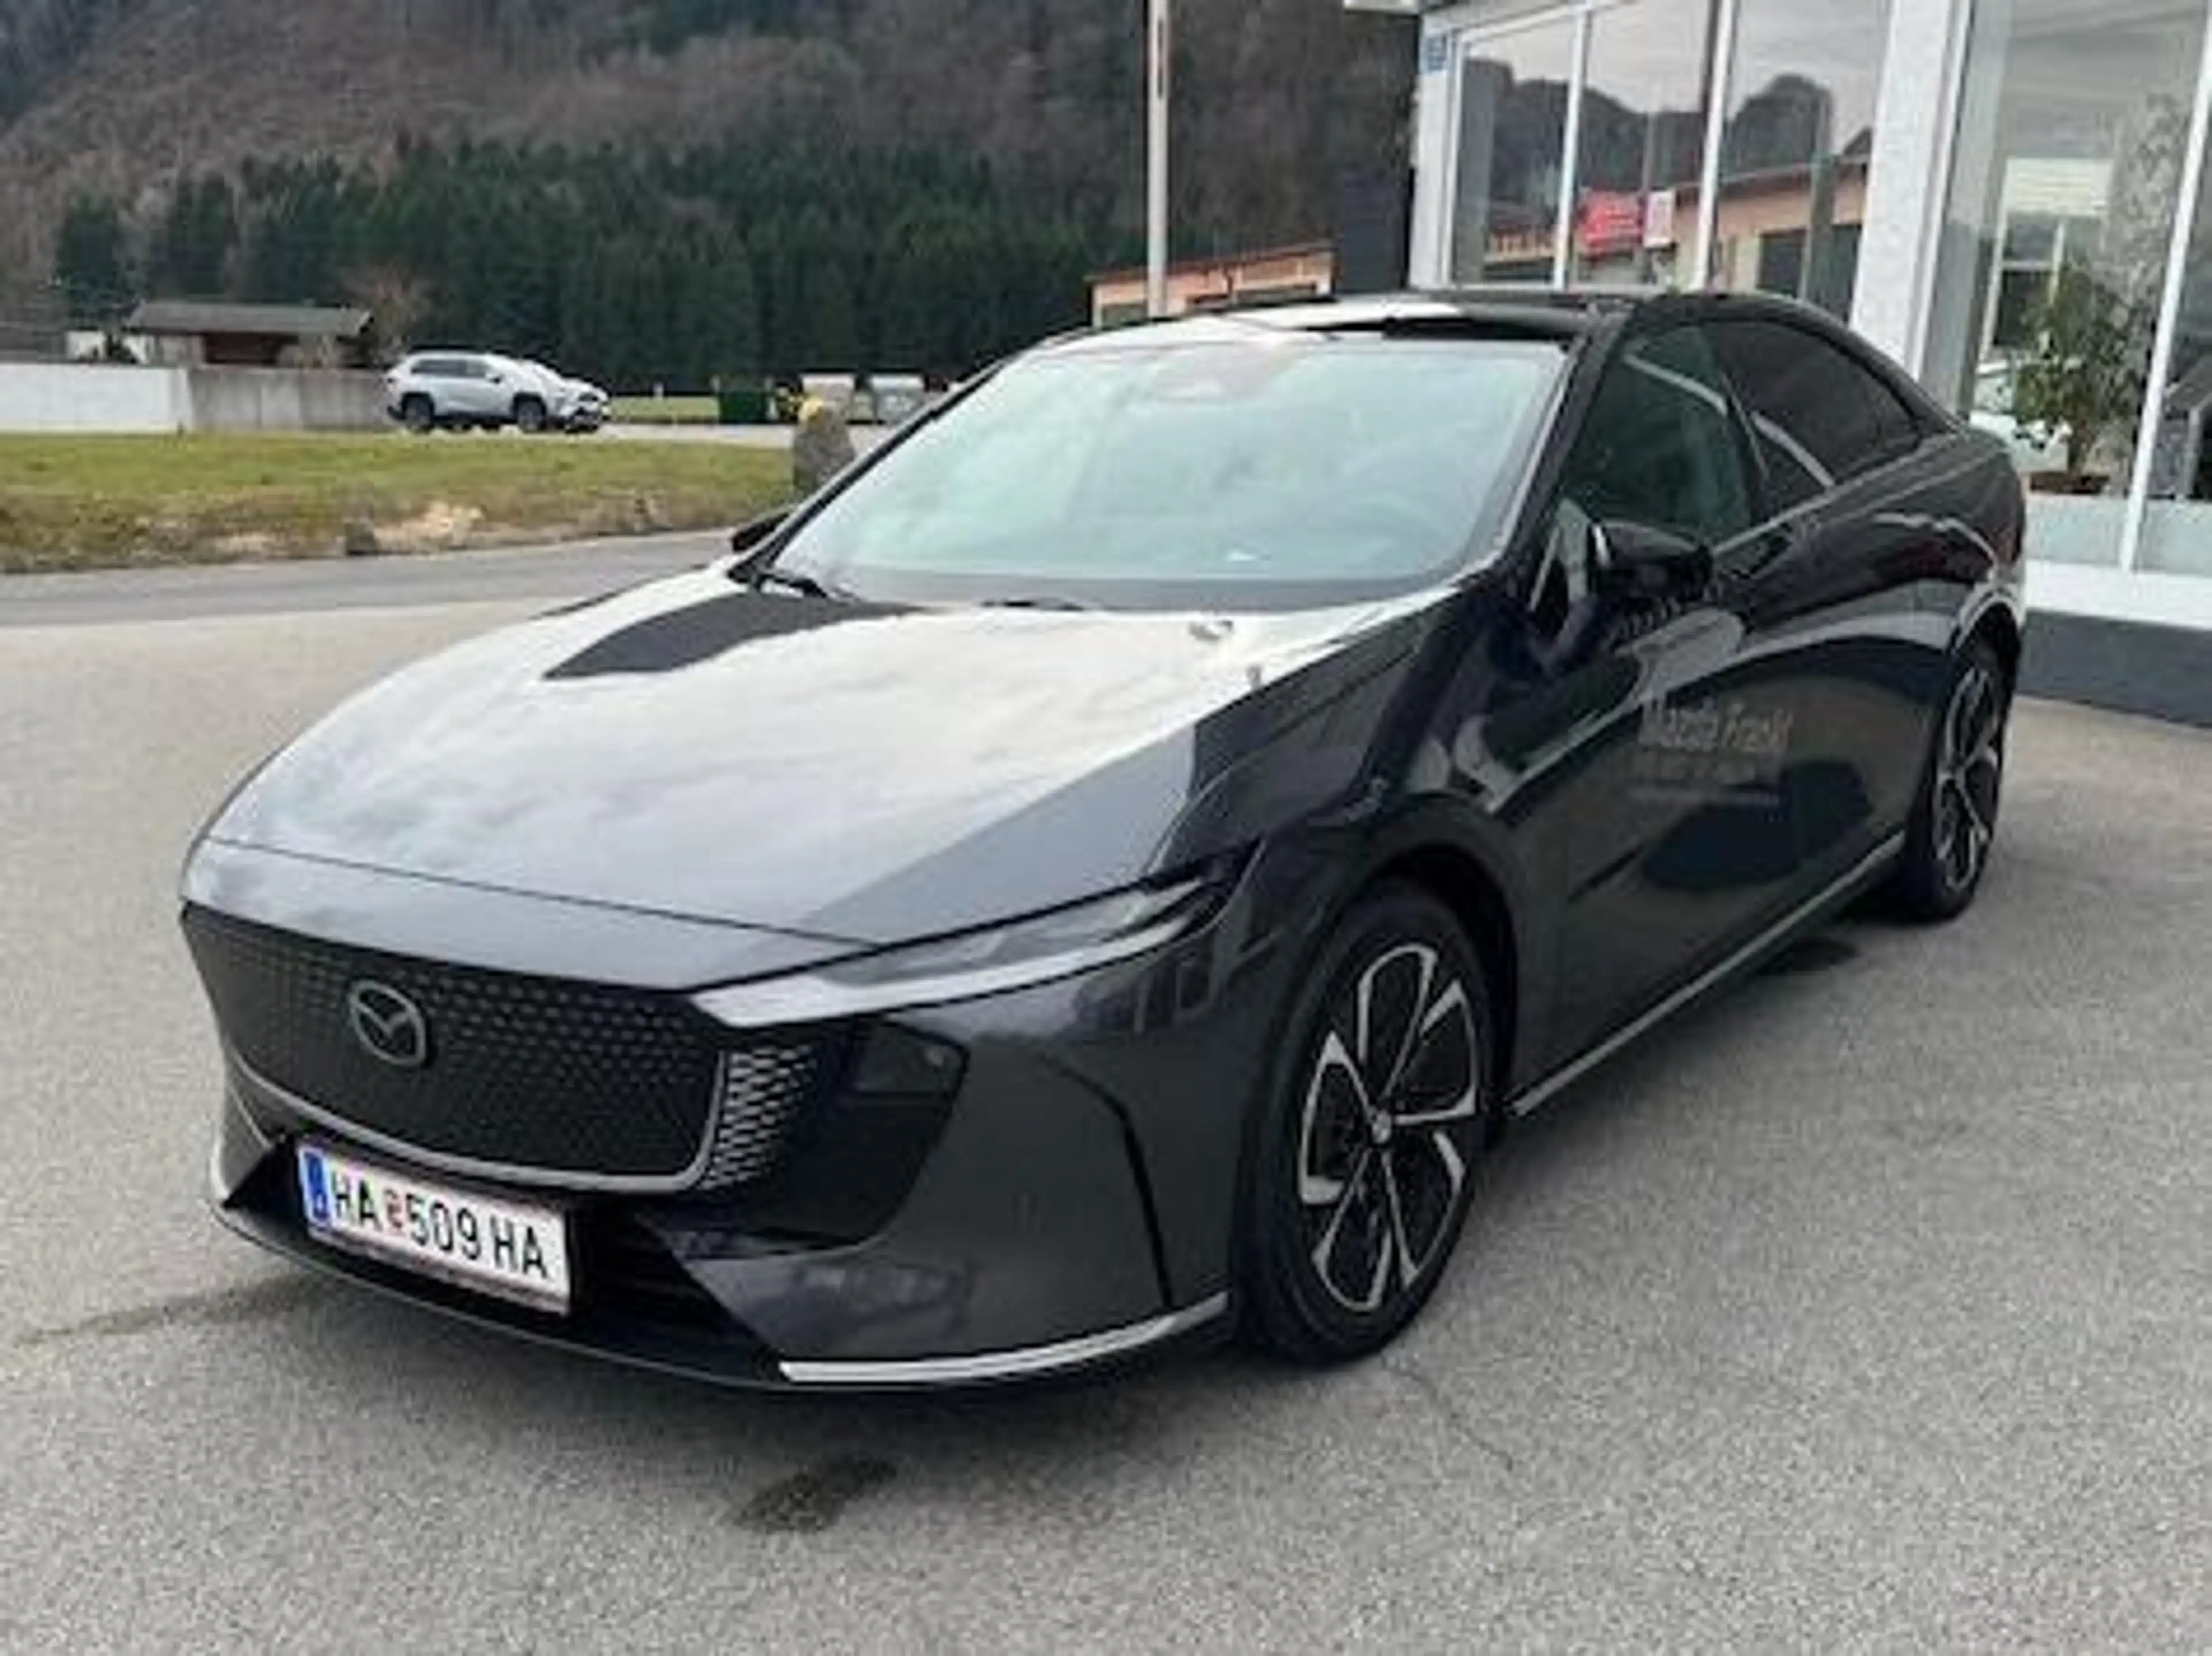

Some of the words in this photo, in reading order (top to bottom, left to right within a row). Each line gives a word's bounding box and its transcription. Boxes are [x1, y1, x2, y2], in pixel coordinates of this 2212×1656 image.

[331, 1170, 383, 1233] HA
[405, 1193, 482, 1261] 509
[490, 1214, 548, 1279] HA
